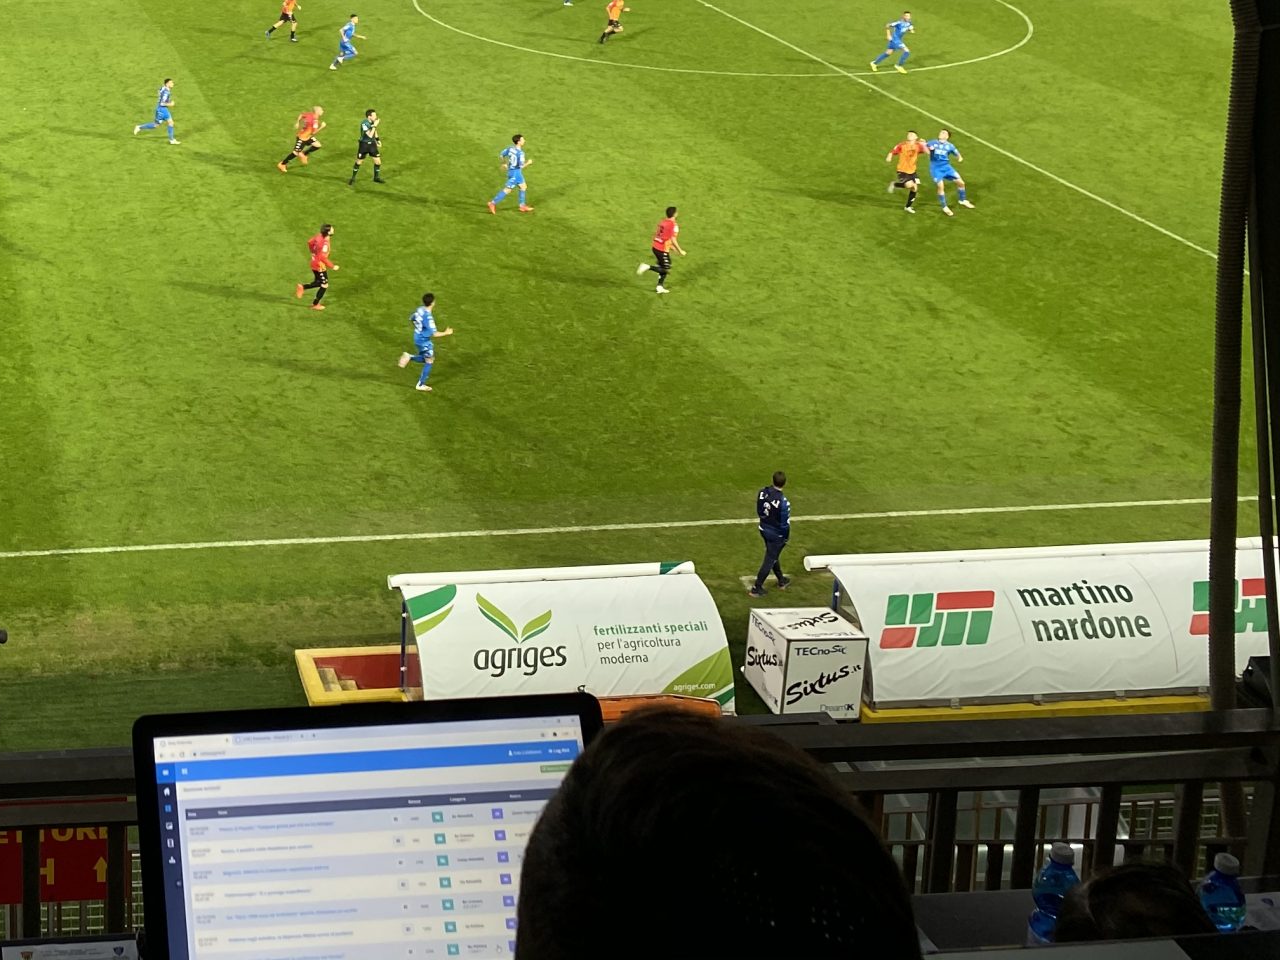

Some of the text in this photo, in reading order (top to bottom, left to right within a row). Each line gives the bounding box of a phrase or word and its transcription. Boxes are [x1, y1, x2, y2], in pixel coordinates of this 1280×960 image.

[1017, 579, 1133, 608] martino
[593, 620, 709, 636] fertilizzanti speciali
[1031, 609, 1152, 642] nardone
[597, 640, 617, 652] per
[473, 645, 568, 678] agriges
[600, 652, 649, 665] moderna
[673, 682, 716, 692] agriges.com
